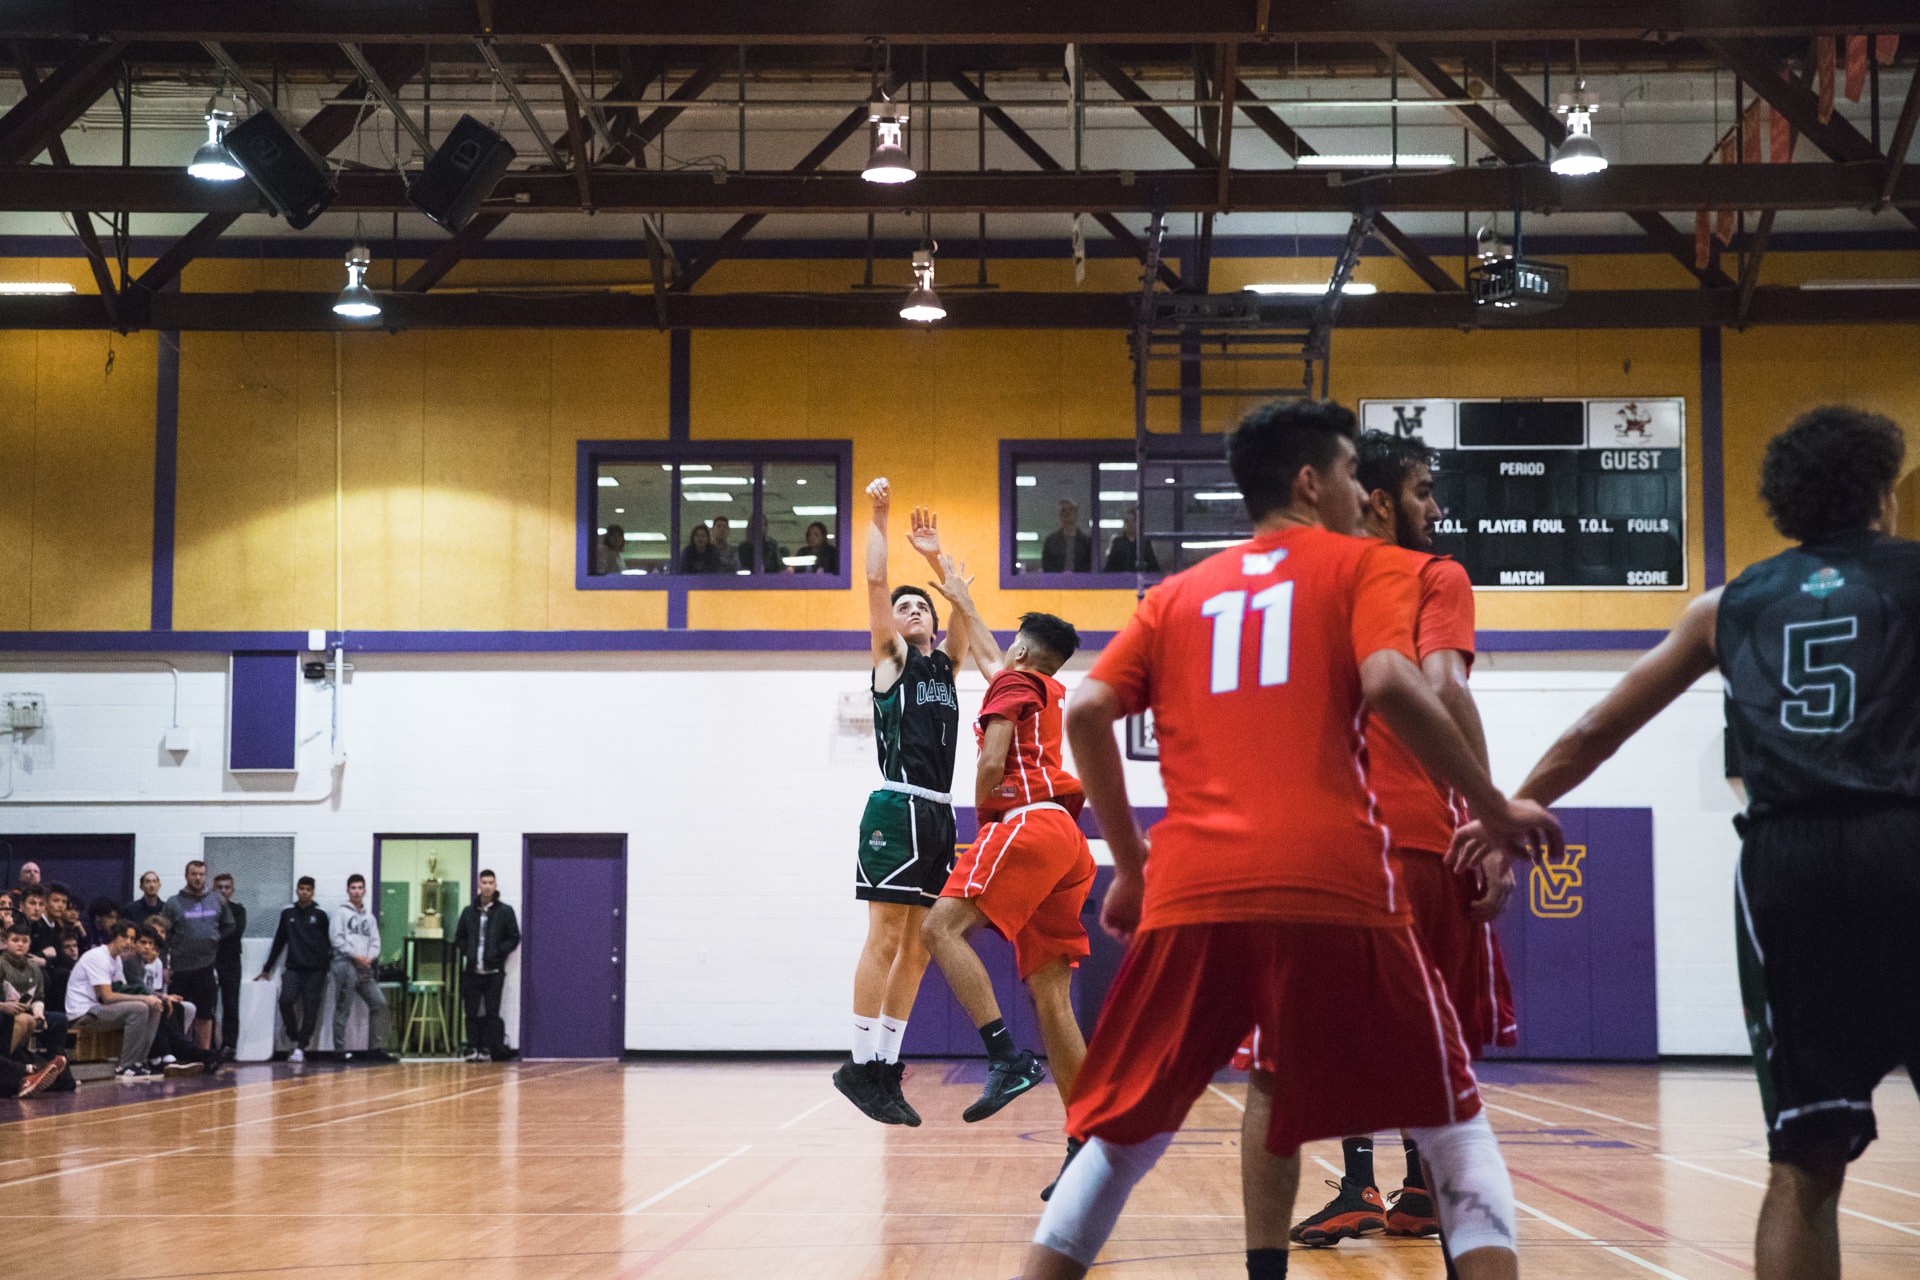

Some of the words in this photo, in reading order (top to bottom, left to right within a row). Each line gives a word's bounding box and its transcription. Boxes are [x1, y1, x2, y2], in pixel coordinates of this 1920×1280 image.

[1600, 451, 1661, 470] GUEST
[1499, 462, 1545, 476] PERIOD
[1478, 519, 1527, 533] PLAYER
[1532, 519, 1566, 533] FOUL
[1578, 518, 1614, 533] T.O.L.
[1627, 518, 1669, 533] FOULS
[1499, 571, 1545, 585] MATCH
[1626, 571, 1669, 585] SCORE
[1200, 579, 1295, 694] 11
[1780, 615, 1857, 732] 5
